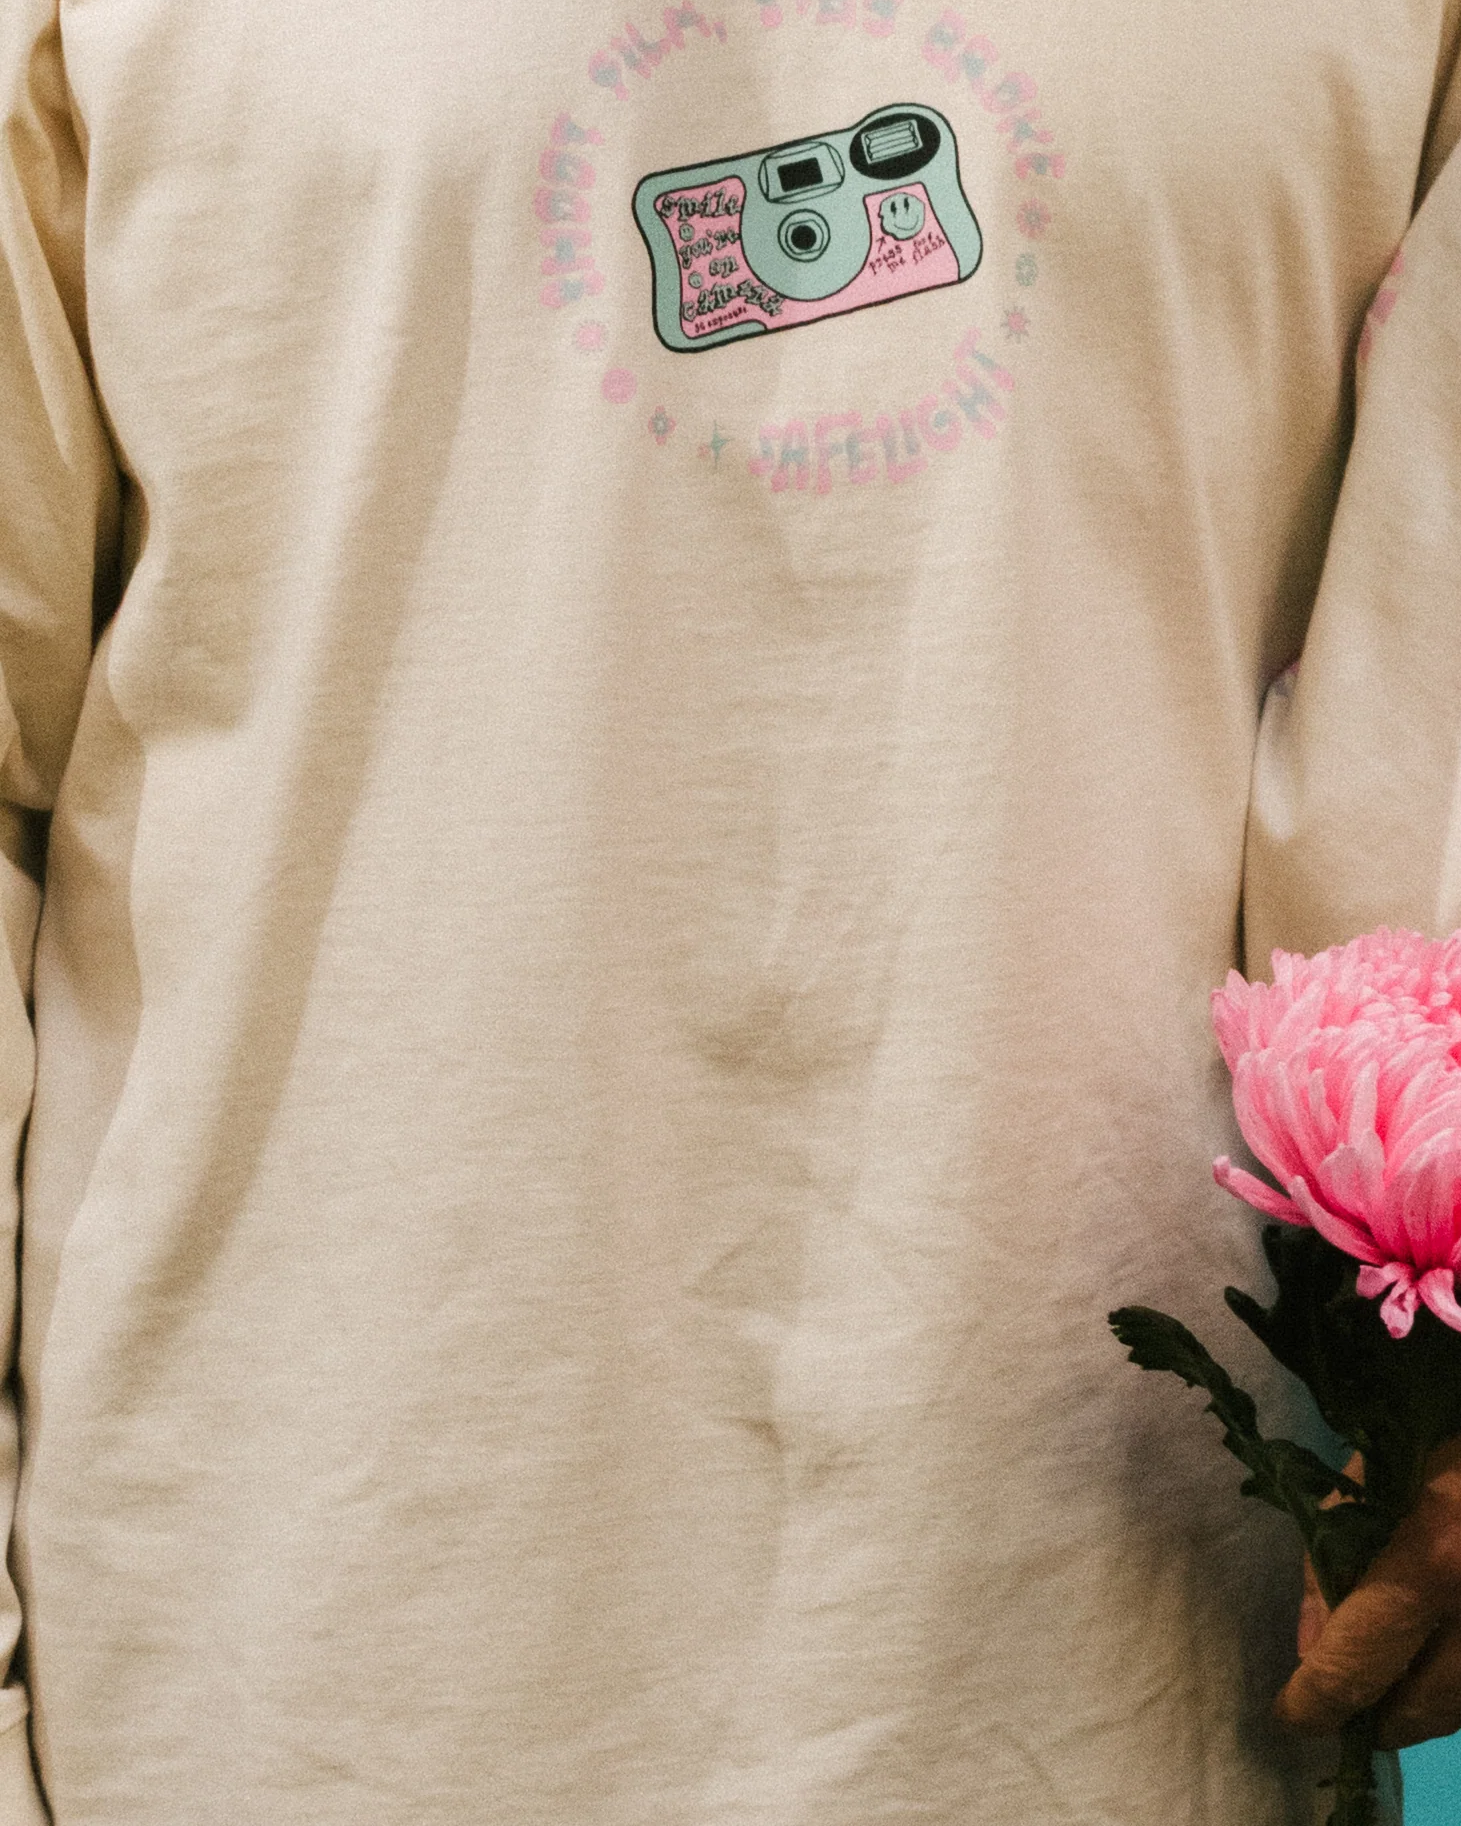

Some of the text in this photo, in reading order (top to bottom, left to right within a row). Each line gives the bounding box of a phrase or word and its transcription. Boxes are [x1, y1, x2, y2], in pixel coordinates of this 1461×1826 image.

[534, 111, 605, 309] SHOOT
[921, 8, 1067, 180] BROKE
[748, 327, 1016, 496] SAFELIGHT
